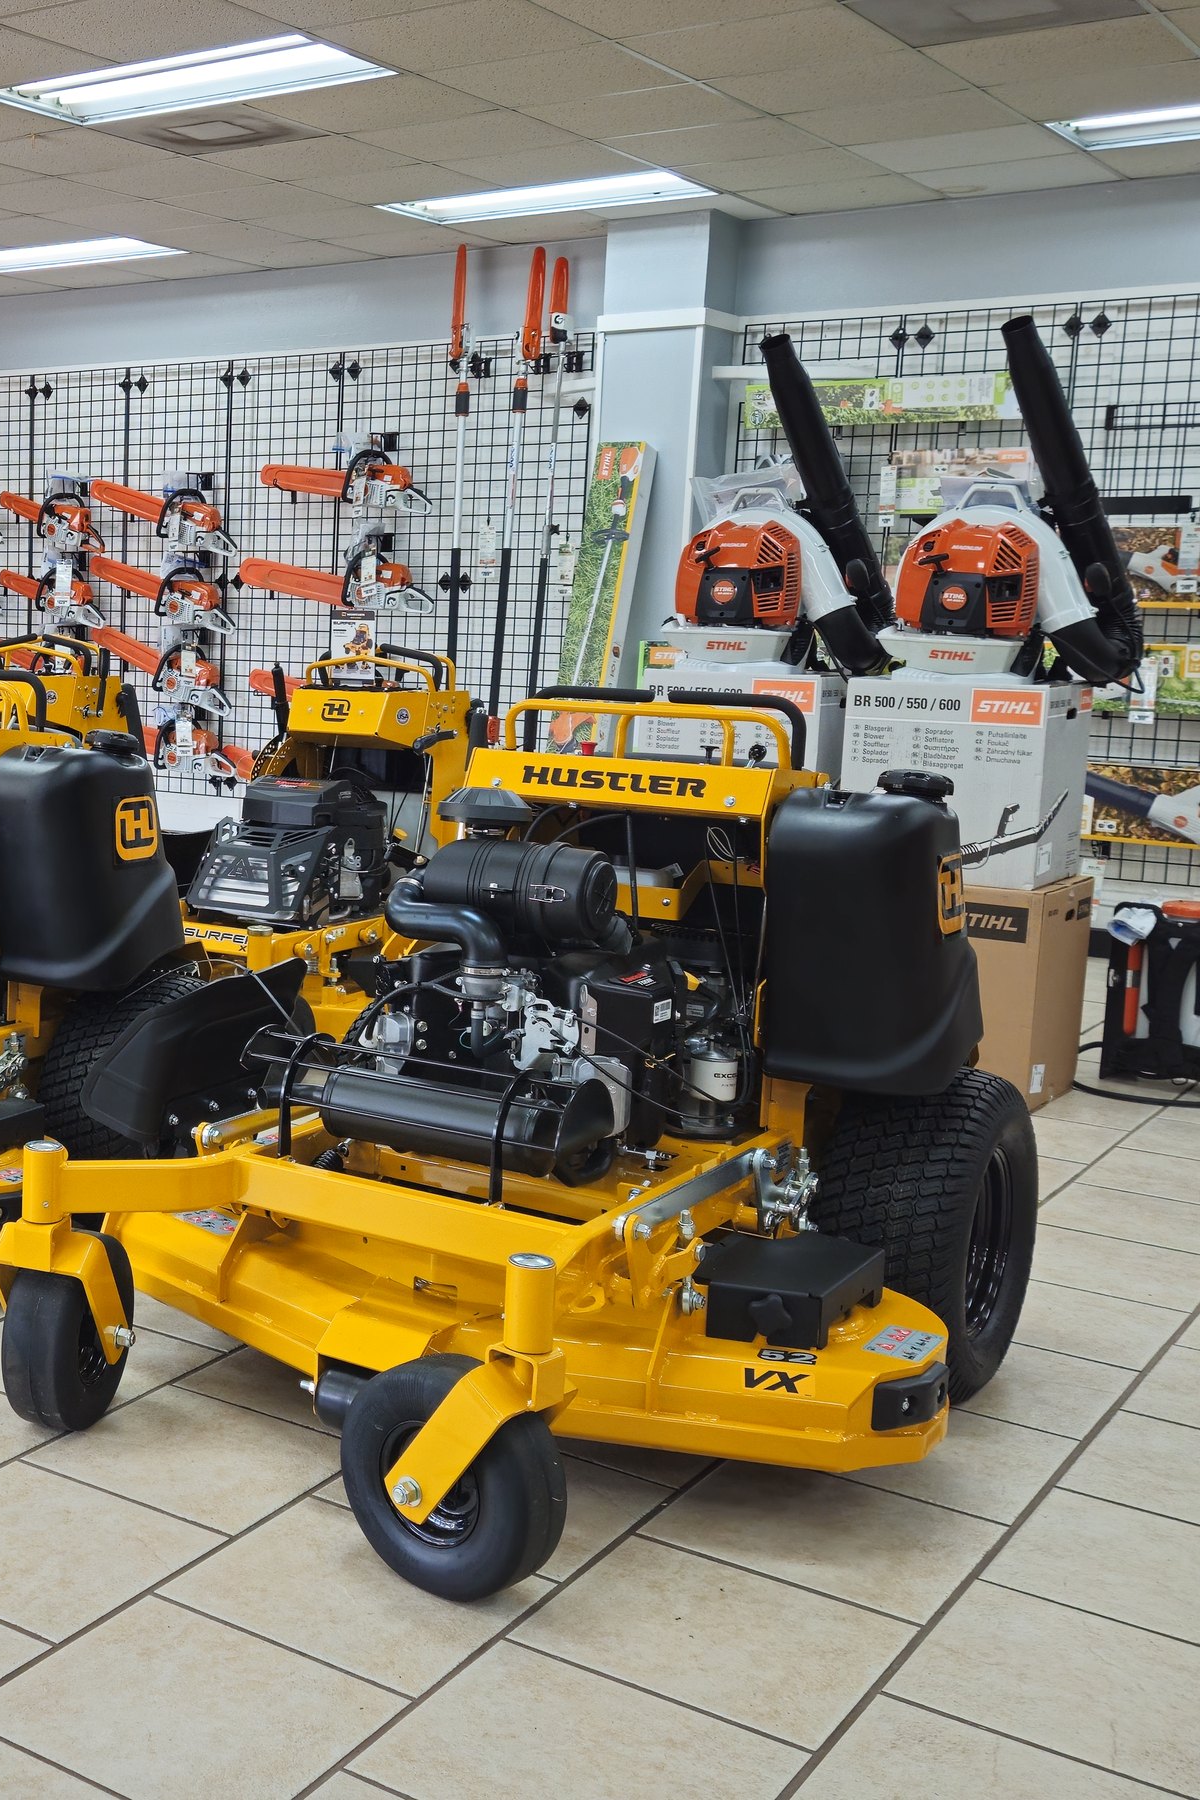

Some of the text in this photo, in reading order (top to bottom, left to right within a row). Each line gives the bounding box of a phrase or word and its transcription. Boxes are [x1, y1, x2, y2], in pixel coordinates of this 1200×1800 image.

[602, 450, 612, 476] STIHL
[706, 641, 746, 650] STIHL
[928, 650, 974, 661] STIHL
[854, 695, 960, 711] BR 500 / 550 / 600
[976, 700, 1035, 715] STIHL
[864, 732, 884, 740] Blower
[862, 740, 890, 748] Souffleur
[862, 748, 889, 756] Soplador
[862, 756, 889, 764] Soprador
[522, 765, 707, 798] HUSTLER
[965, 912, 1018, 932] TIHL
[184, 928, 248, 944] SURFE
[760, 1350, 817, 1365] 52
[744, 1367, 810, 1395] VX
